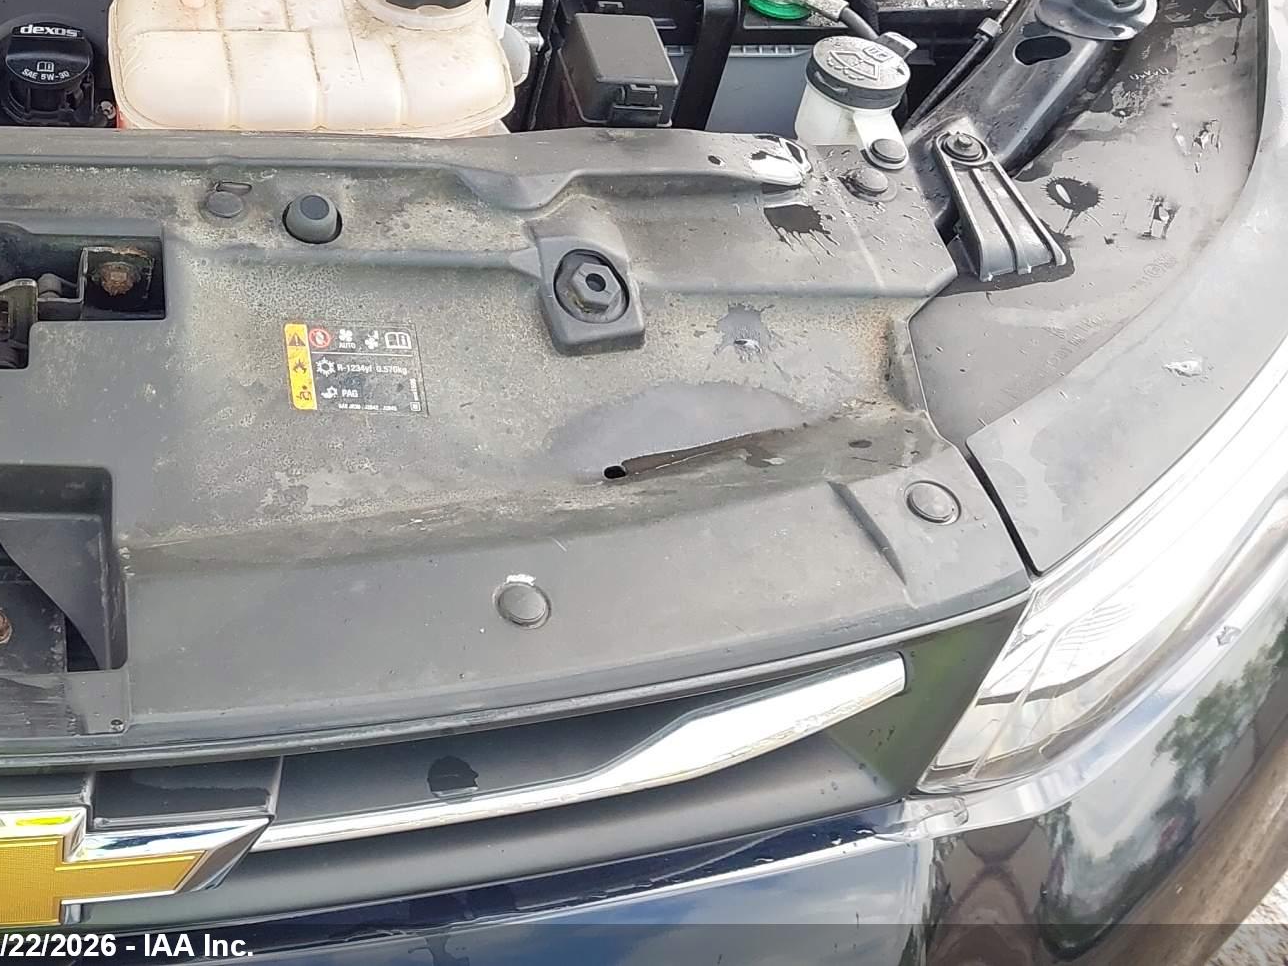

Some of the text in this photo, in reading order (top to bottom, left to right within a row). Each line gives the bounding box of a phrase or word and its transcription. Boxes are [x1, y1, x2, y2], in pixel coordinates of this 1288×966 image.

[20, 24, 78, 37] dexos
[22, 68, 70, 81] SAE 5W-30
[342, 389, 359, 398] PAG
